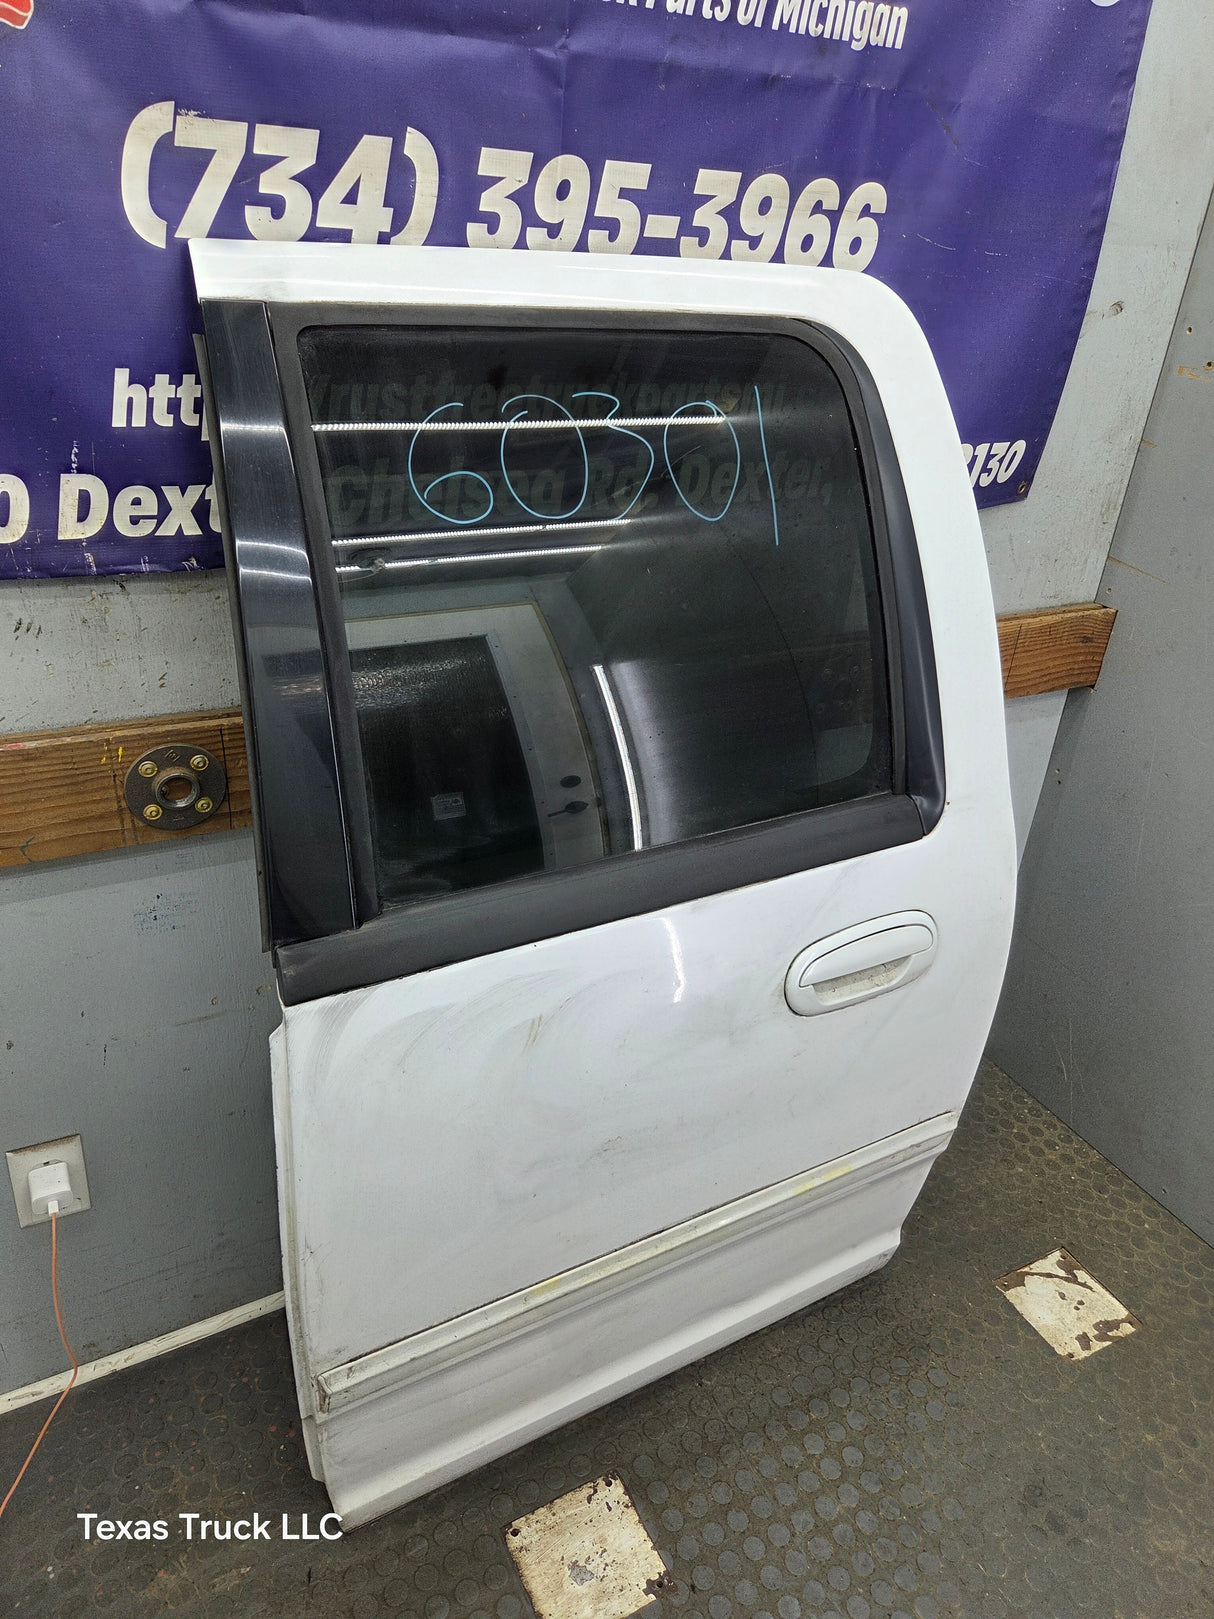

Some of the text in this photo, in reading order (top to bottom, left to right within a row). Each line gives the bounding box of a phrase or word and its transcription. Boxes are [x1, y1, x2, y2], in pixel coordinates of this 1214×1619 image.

[771, 0, 909, 50] Michigan
[121, 101, 888, 272] (734) 395-3966
[112, 368, 210, 441] htt
[408, 385, 779, 546] 60301
